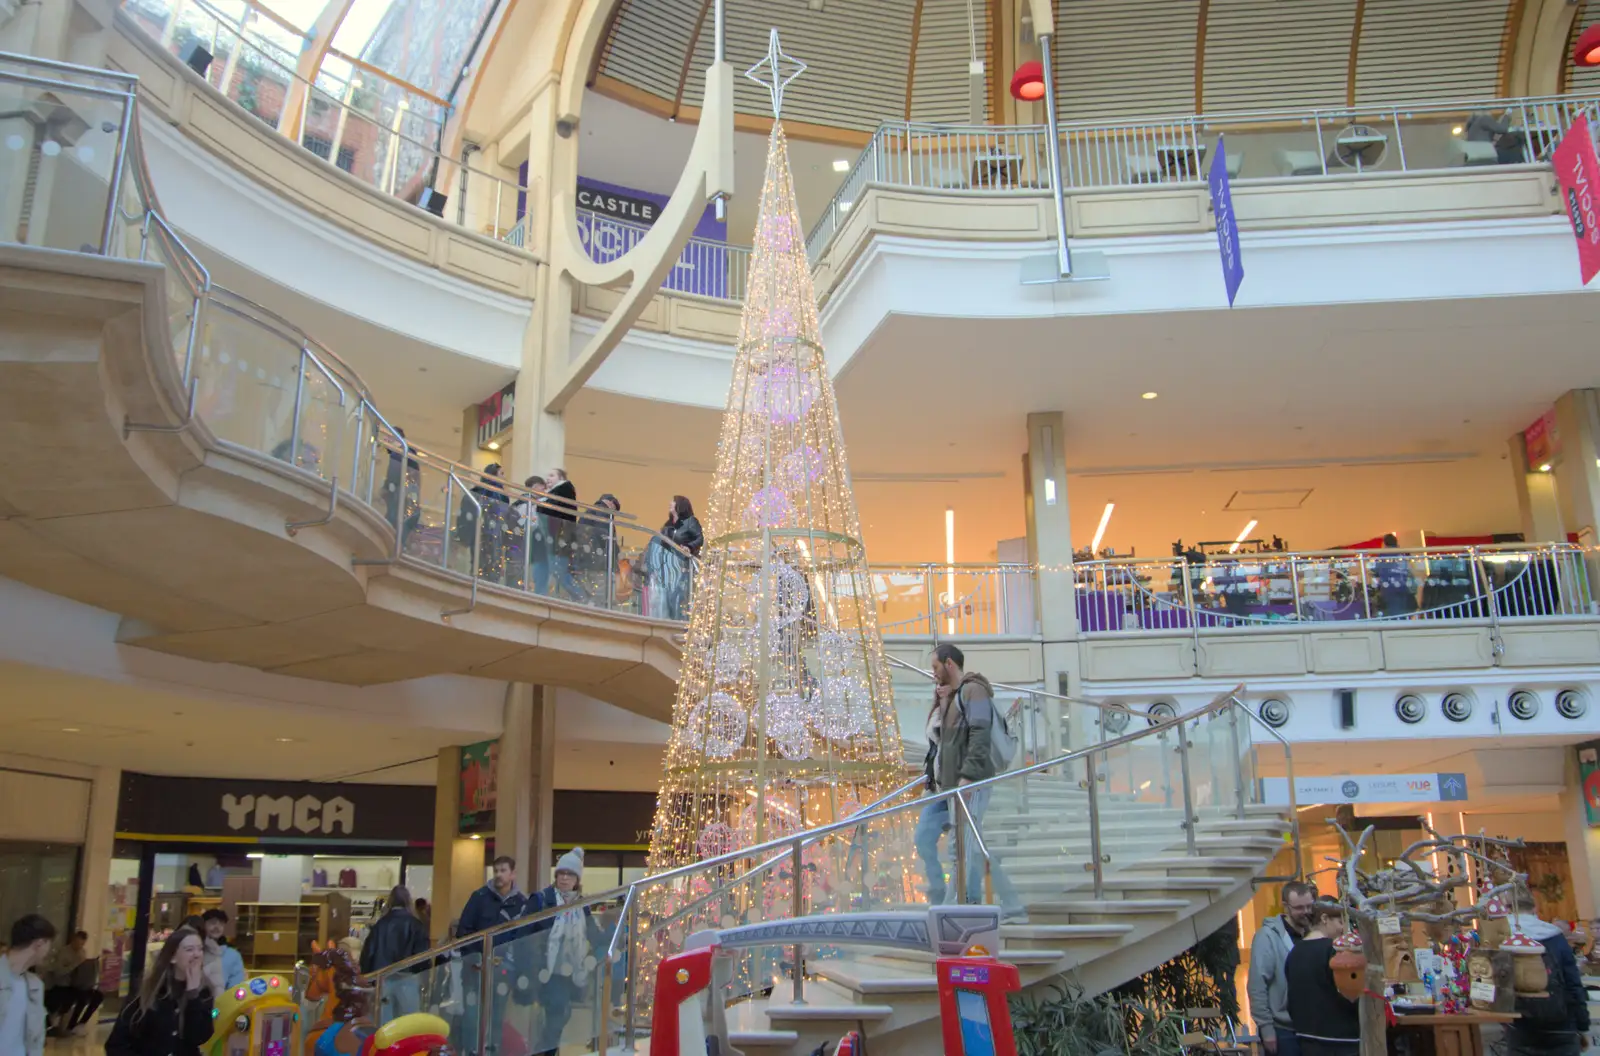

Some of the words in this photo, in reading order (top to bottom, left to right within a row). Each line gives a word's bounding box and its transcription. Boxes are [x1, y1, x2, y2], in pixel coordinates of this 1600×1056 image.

[578, 191, 652, 219] CASTLE
[1573, 153, 1600, 245] SOCIAL
[1406, 780, 1432, 791] vue
[221, 793, 355, 834] YMCA
